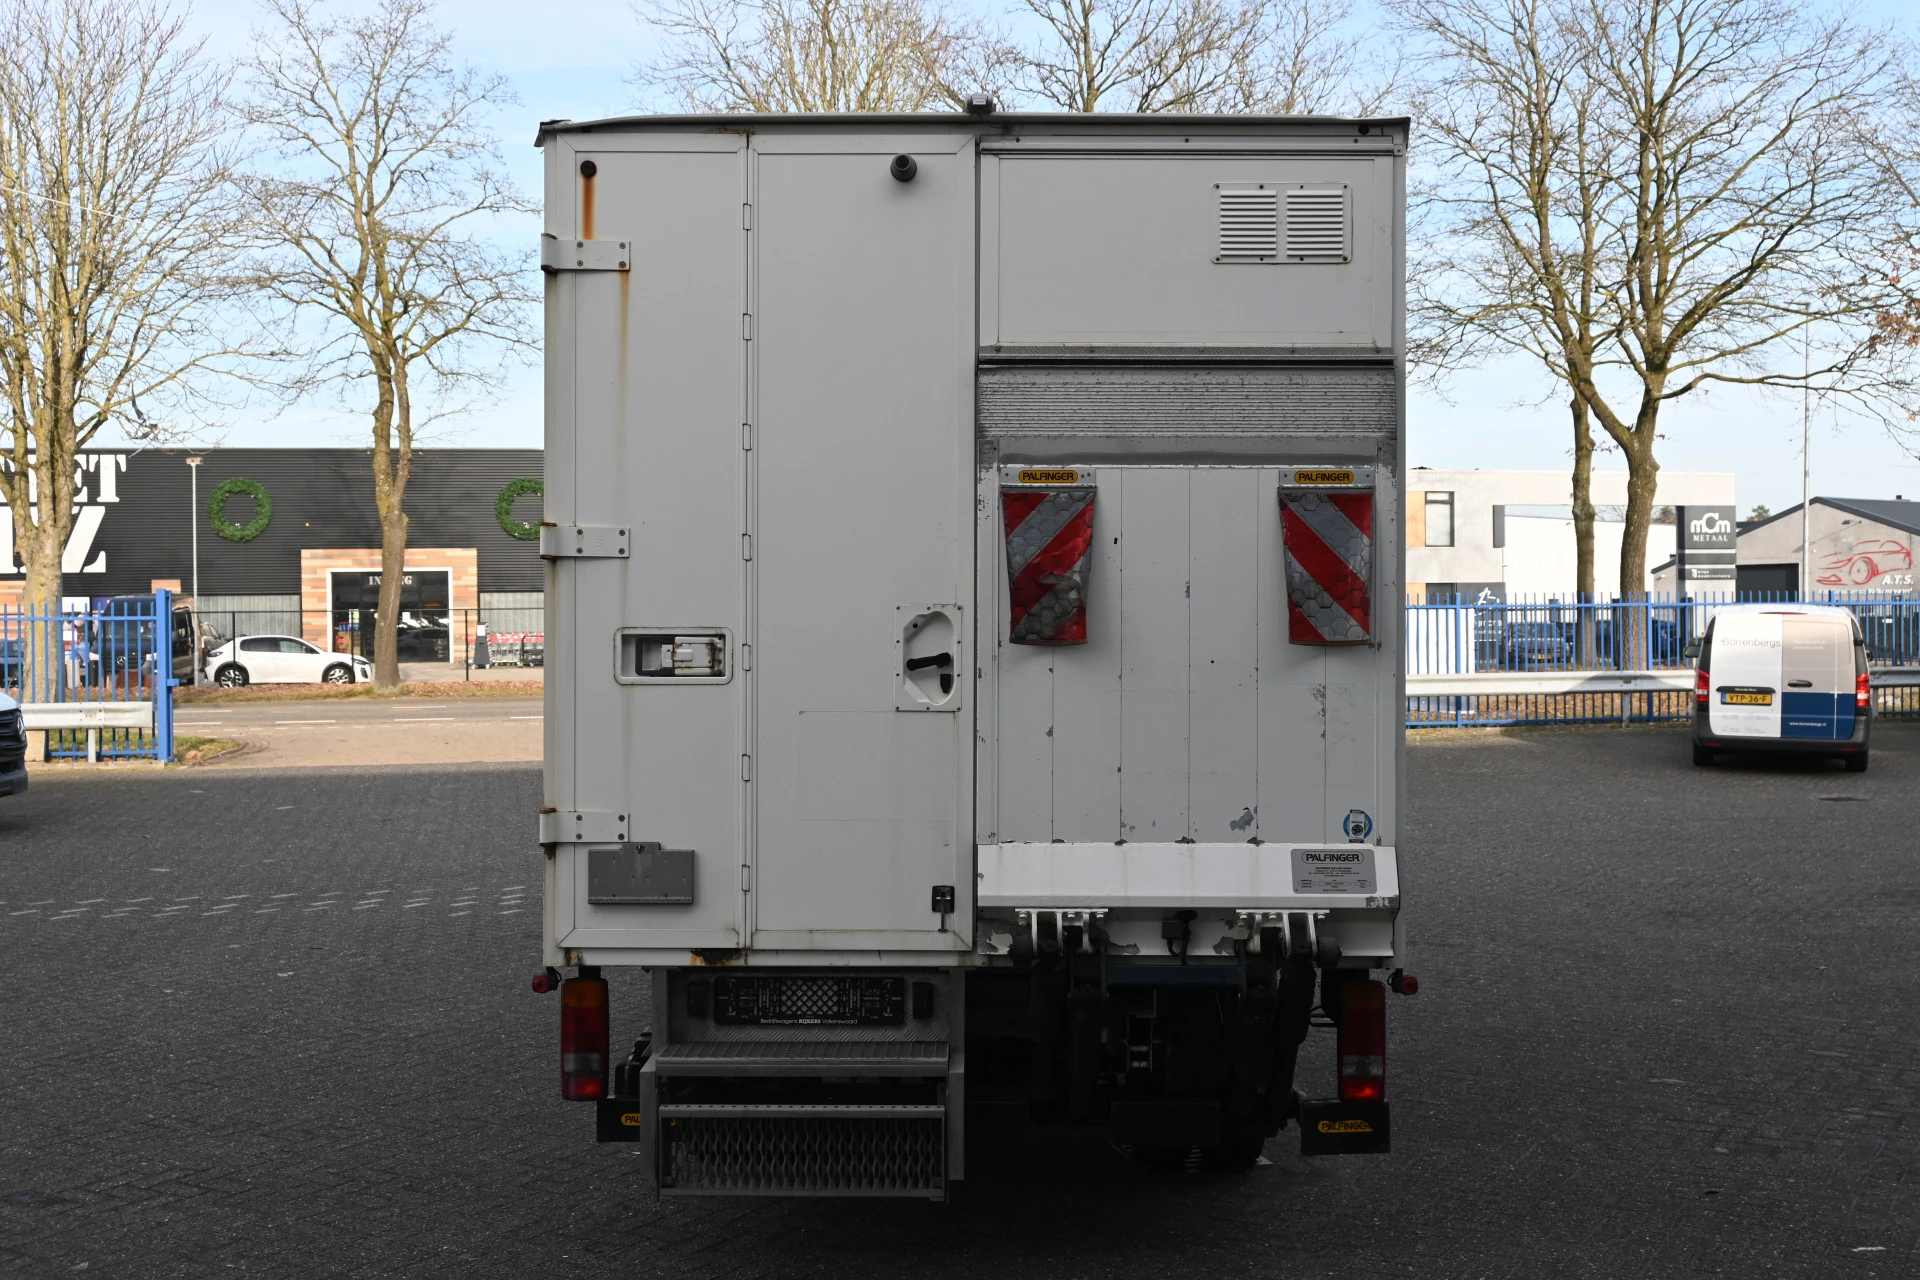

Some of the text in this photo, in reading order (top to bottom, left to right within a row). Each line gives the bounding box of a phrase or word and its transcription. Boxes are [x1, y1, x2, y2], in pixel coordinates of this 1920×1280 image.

[1022, 472, 1074, 481] PALFINGER
[1298, 473, 1350, 482] PALFINGER
[1693, 534, 1729, 542] METAAL
[1882, 574, 1914, 585] A.T.S.
[1721, 637, 1782, 649] Borrenbergs
[1729, 694, 1768, 703] VTP-36-F
[1305, 853, 1360, 862] PALFINGER
